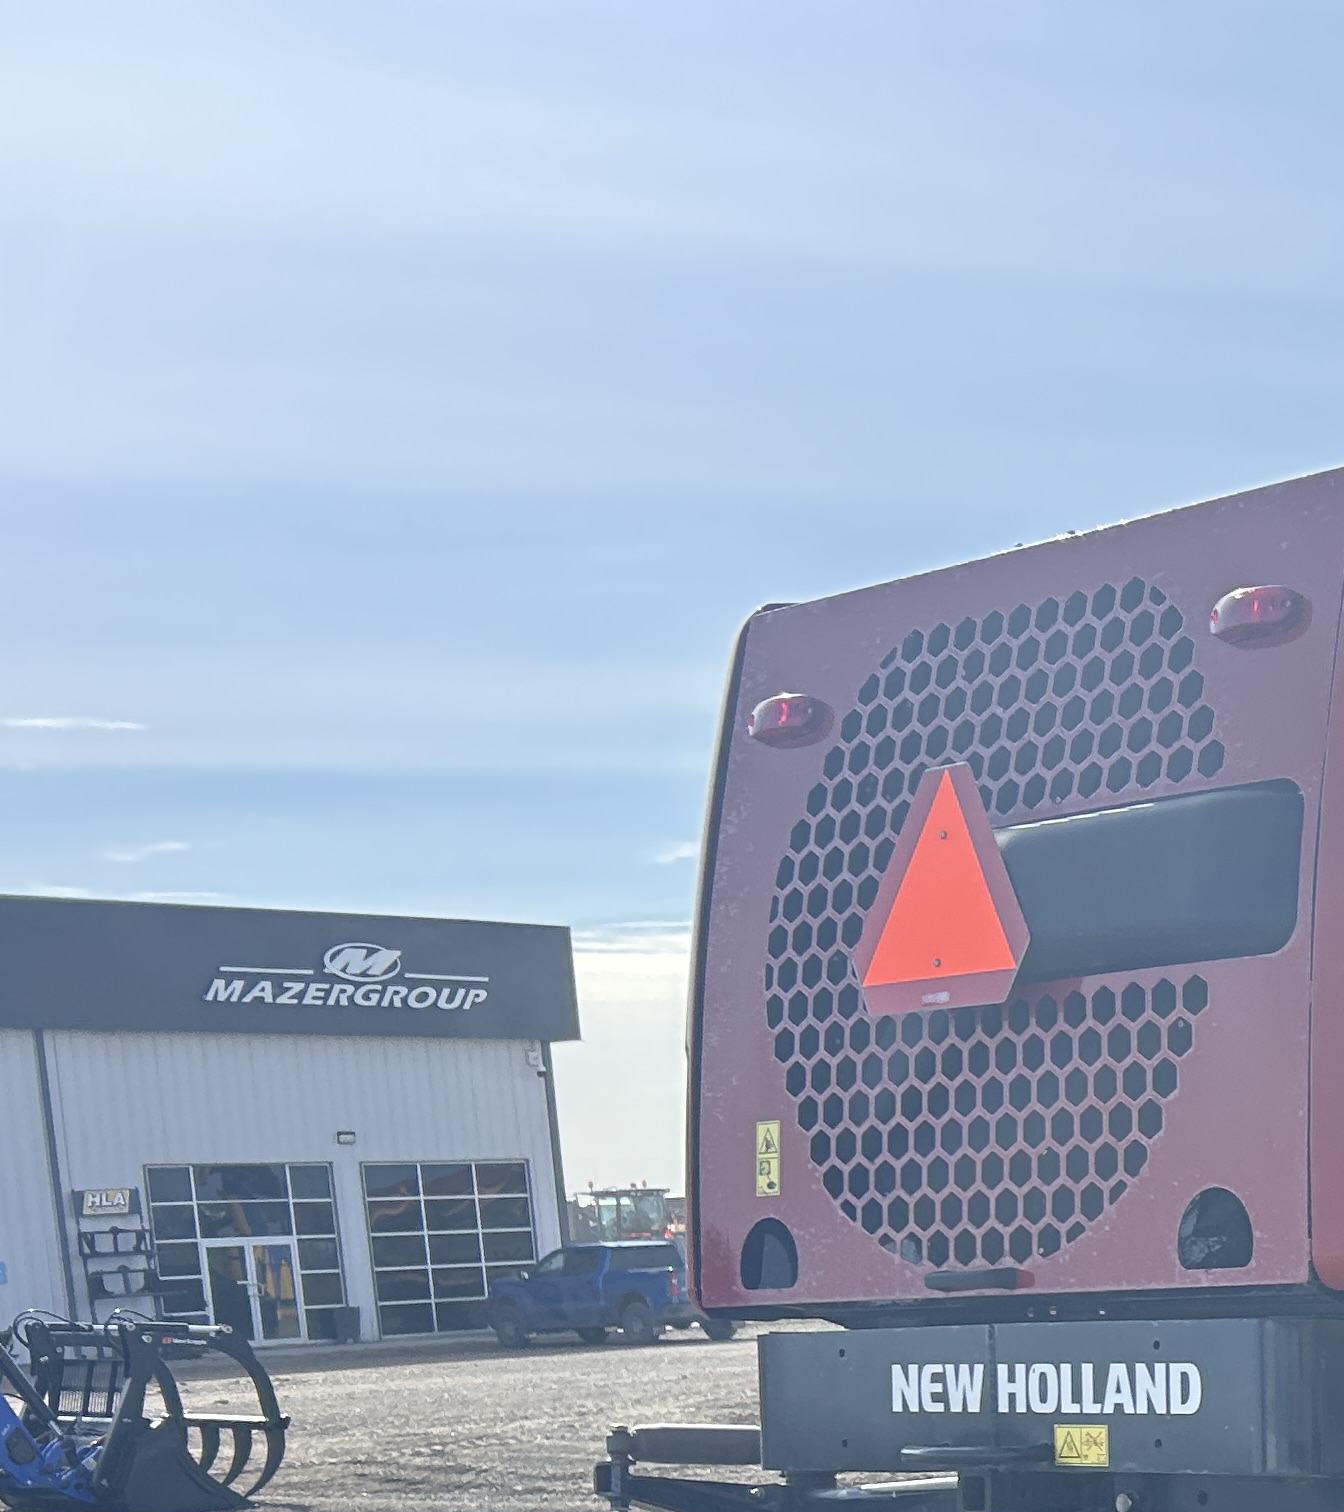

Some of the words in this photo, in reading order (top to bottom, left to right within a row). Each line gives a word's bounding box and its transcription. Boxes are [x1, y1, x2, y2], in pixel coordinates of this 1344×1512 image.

[203, 978, 489, 1010] MAZERGROUP
[86, 1191, 126, 1208] HLA
[891, 1364, 984, 1413] NEW
[996, 1362, 1202, 1415] HOLLAND
